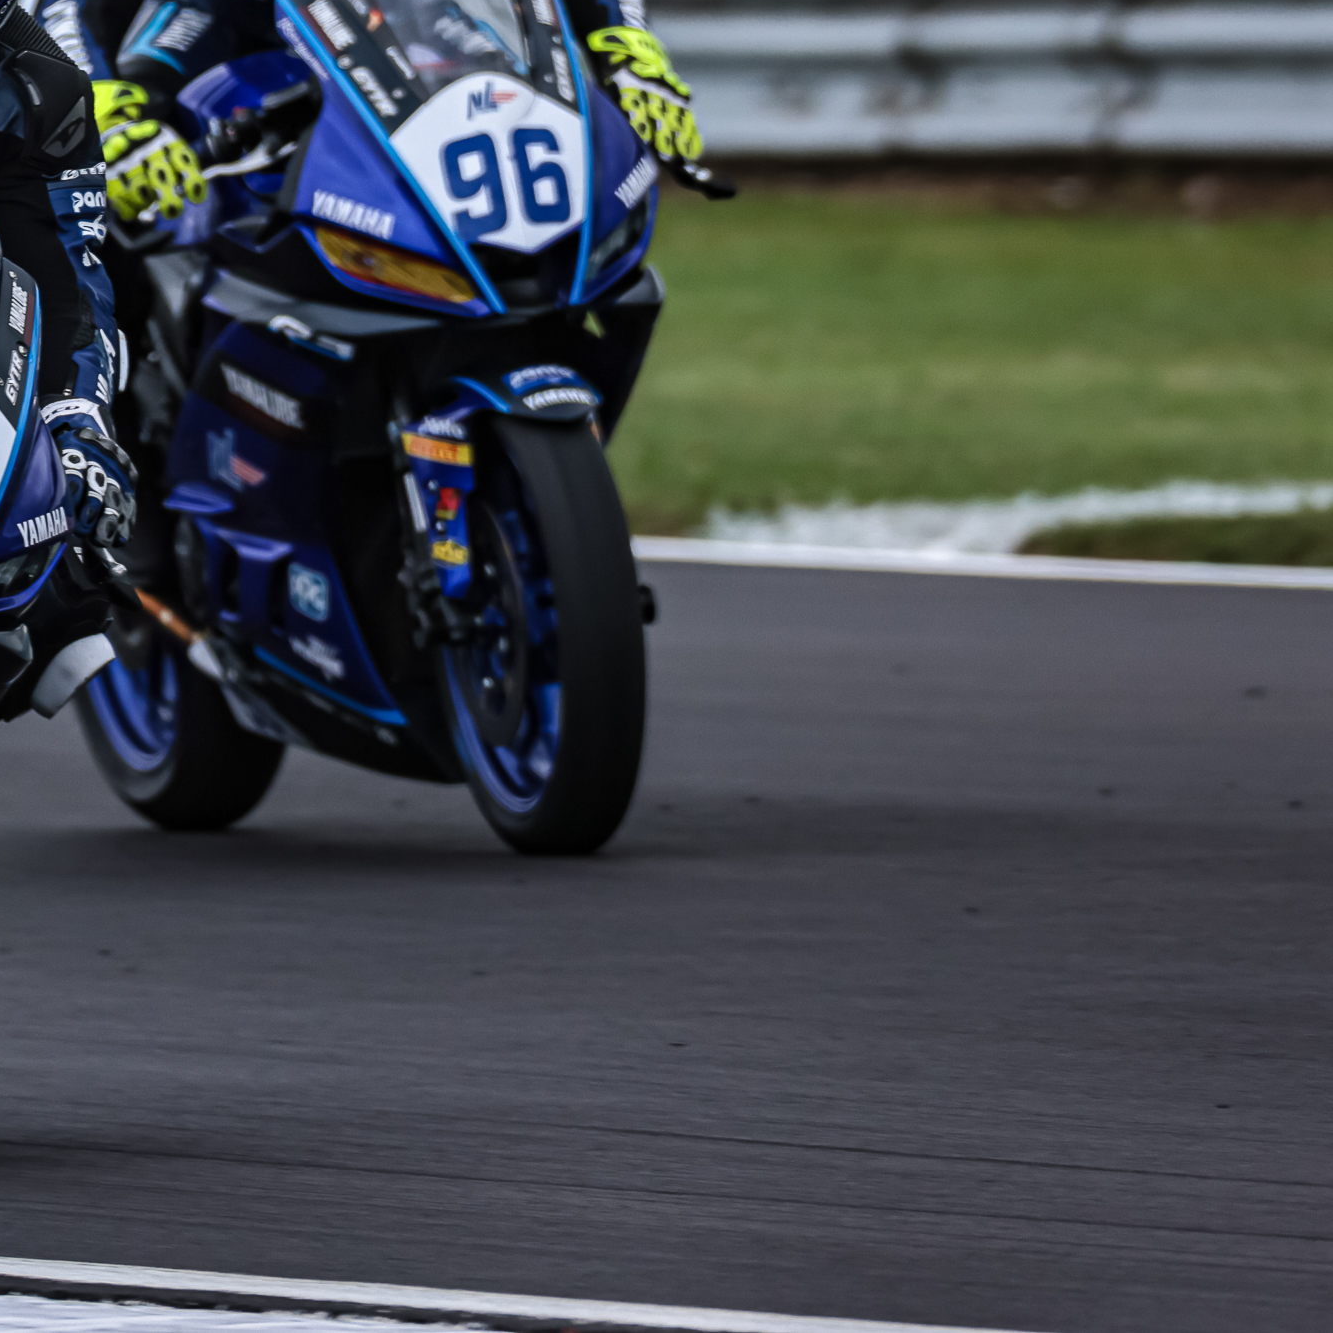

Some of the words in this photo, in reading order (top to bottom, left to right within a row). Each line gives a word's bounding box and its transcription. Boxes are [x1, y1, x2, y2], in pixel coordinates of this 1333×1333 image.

[443, 127, 571, 241] 96
[312, 189, 396, 239] YAMAHA
[17, 507, 69, 547] YAMAHA
